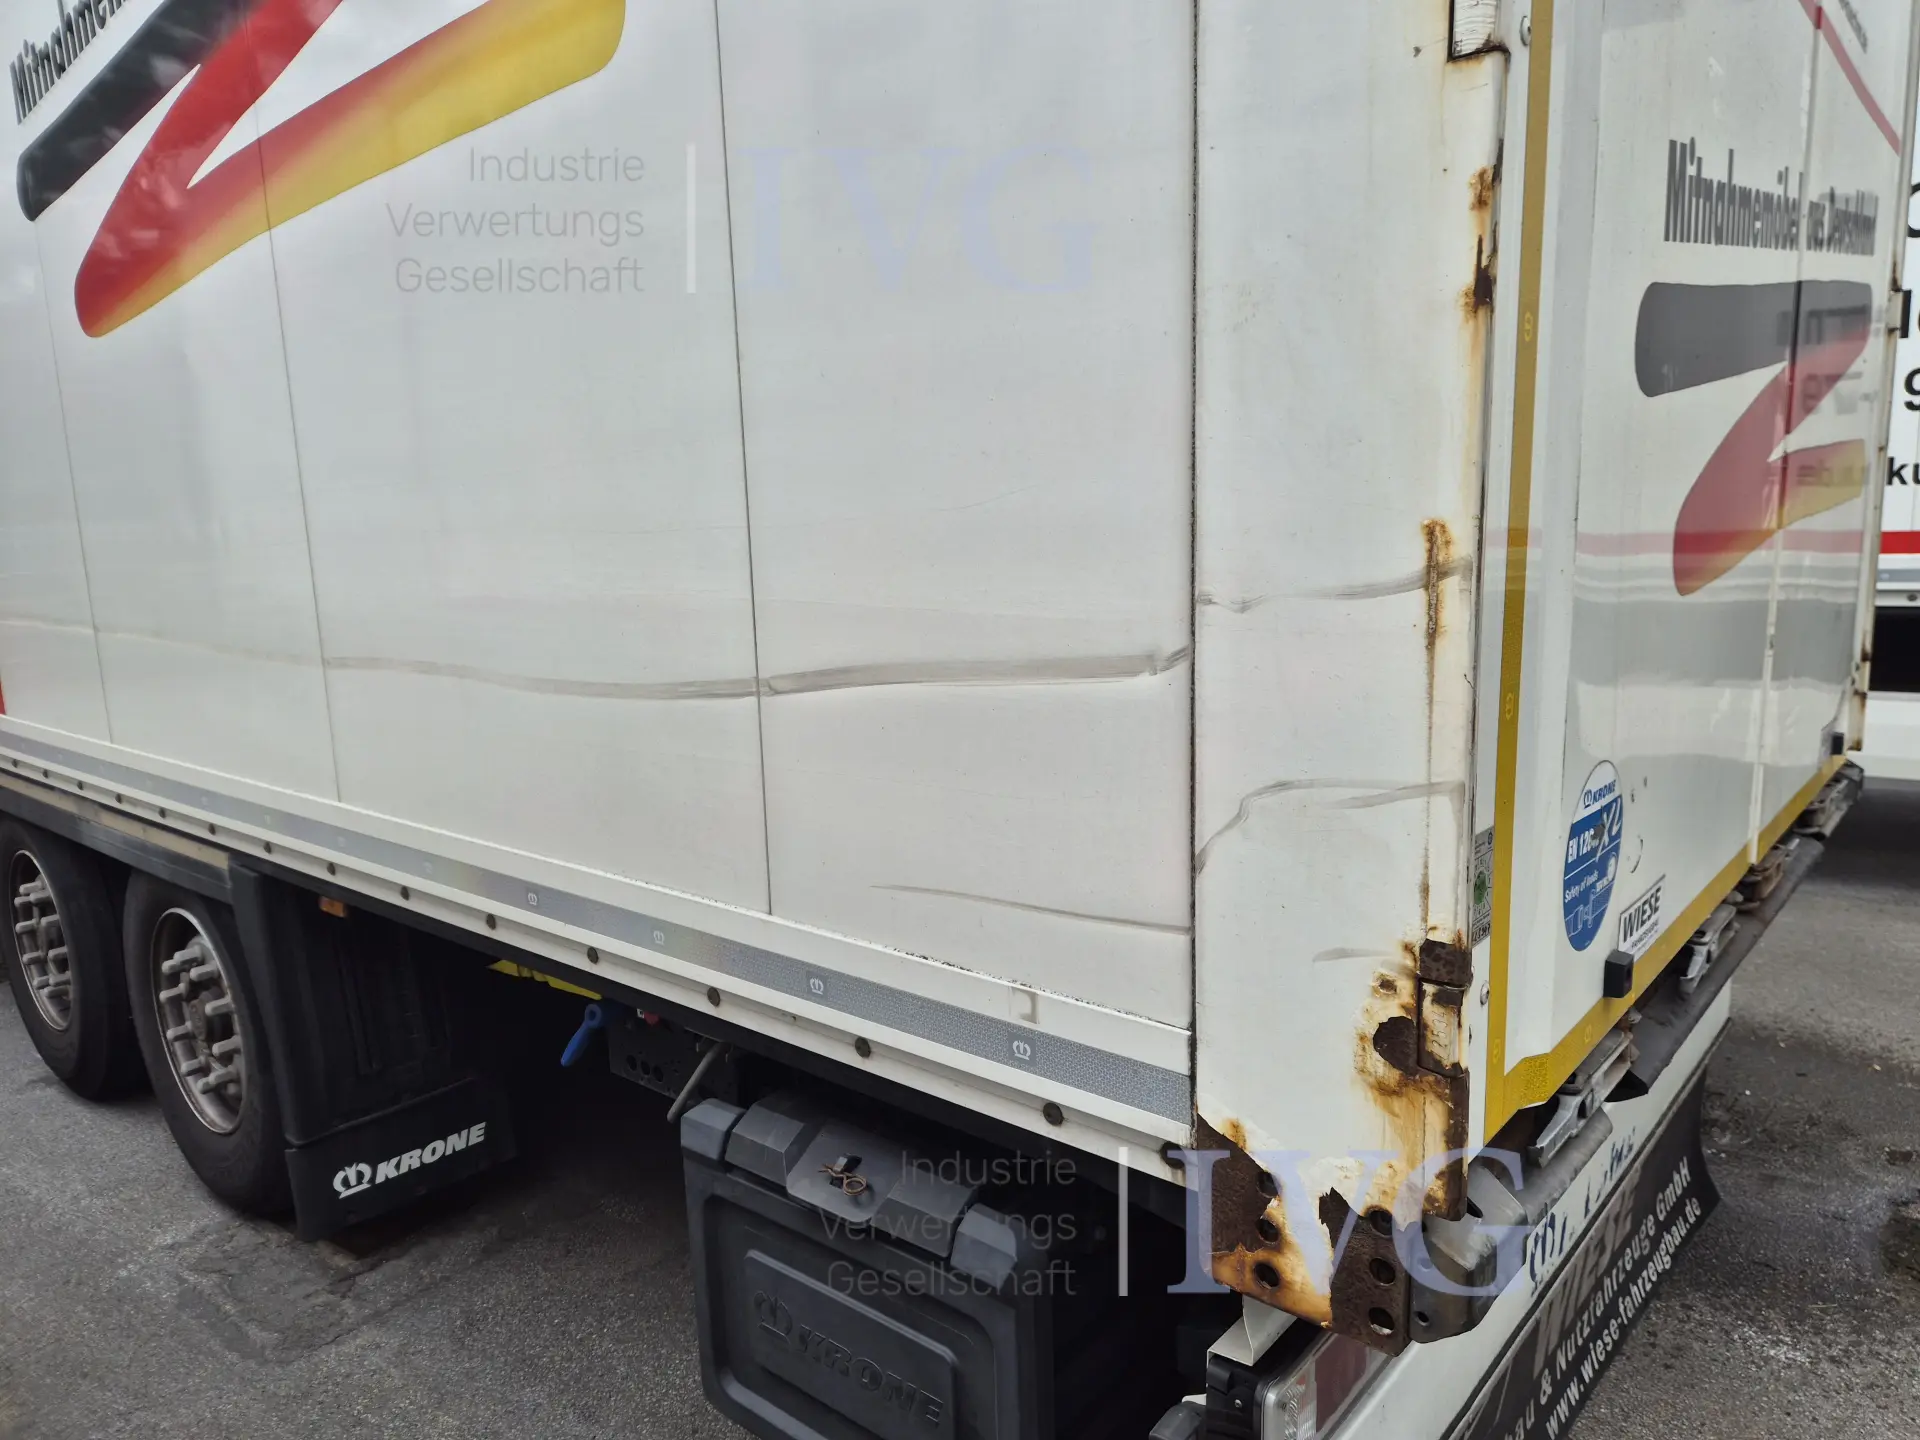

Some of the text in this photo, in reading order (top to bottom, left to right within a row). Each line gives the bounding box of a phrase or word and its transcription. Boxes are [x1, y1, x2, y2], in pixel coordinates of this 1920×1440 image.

[1592, 780, 1616, 802] KRONE
[1623, 886, 1661, 943] WIESE
[375, 1121, 486, 1184] KRONE
[1540, 1367, 1553, 1406] &
[1556, 1213, 1656, 1380] Nutzfahrzeuge
[1656, 1156, 1692, 1222] GmbH
[1546, 1197, 1702, 1440] www.wiese-fahrzeugbau.de
